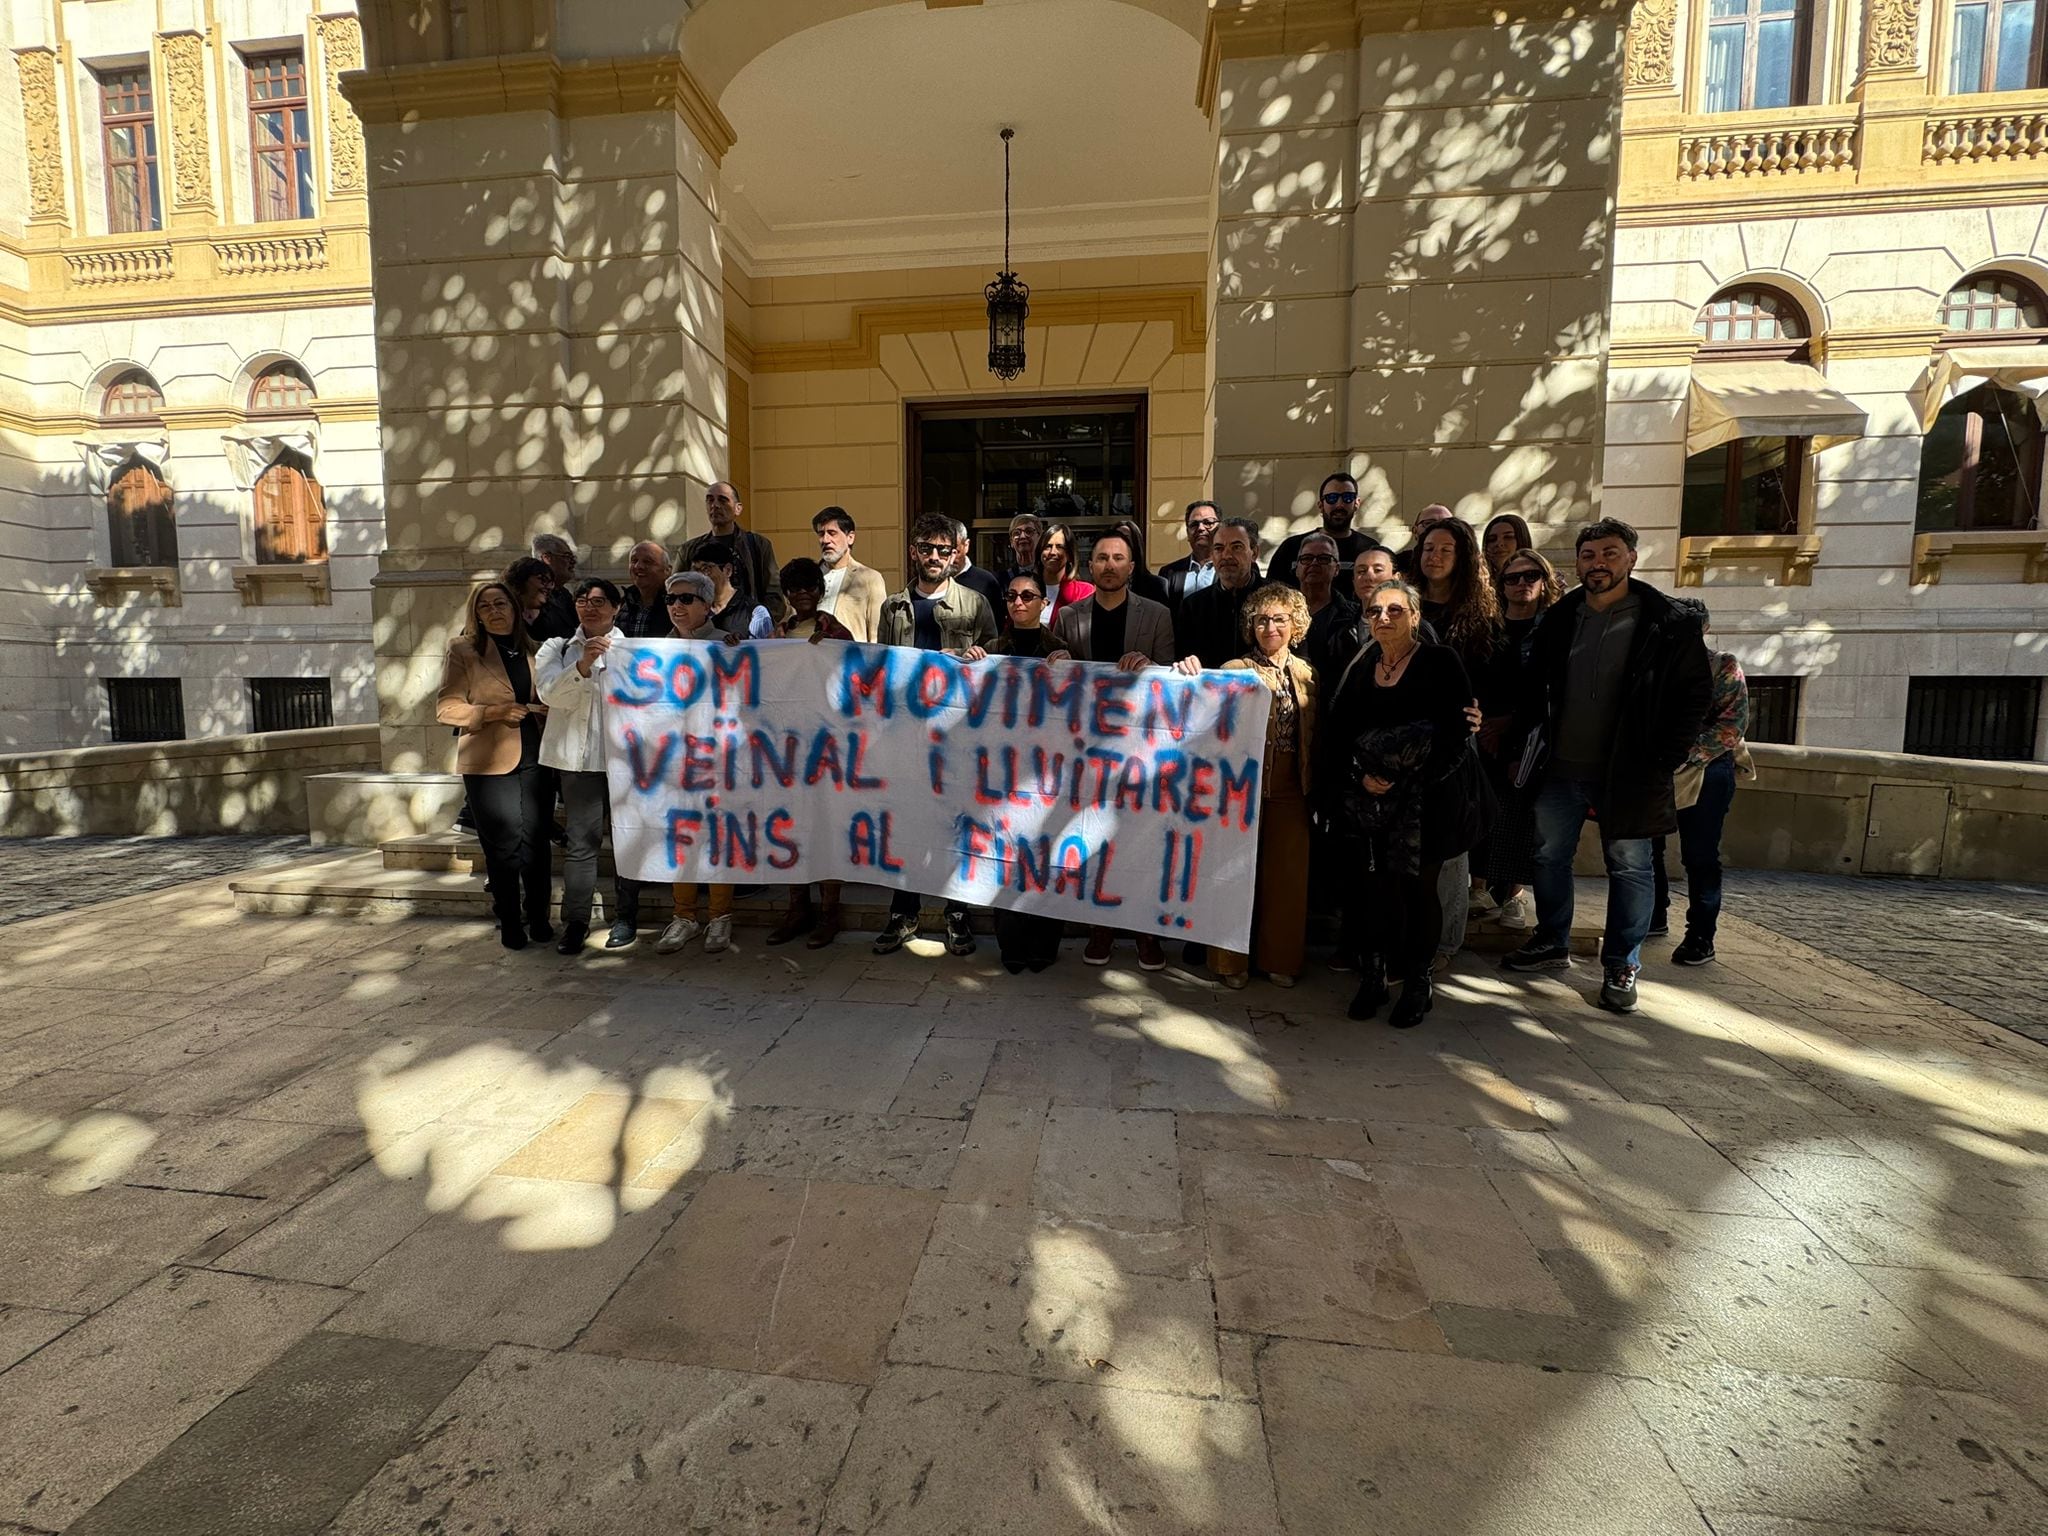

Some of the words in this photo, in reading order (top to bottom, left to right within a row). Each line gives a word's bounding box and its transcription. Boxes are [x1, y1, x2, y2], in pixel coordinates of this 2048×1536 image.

[607, 645, 760, 712] SOM
[840, 645, 1259, 743] MOVIMENT
[851, 811, 905, 872] AL
